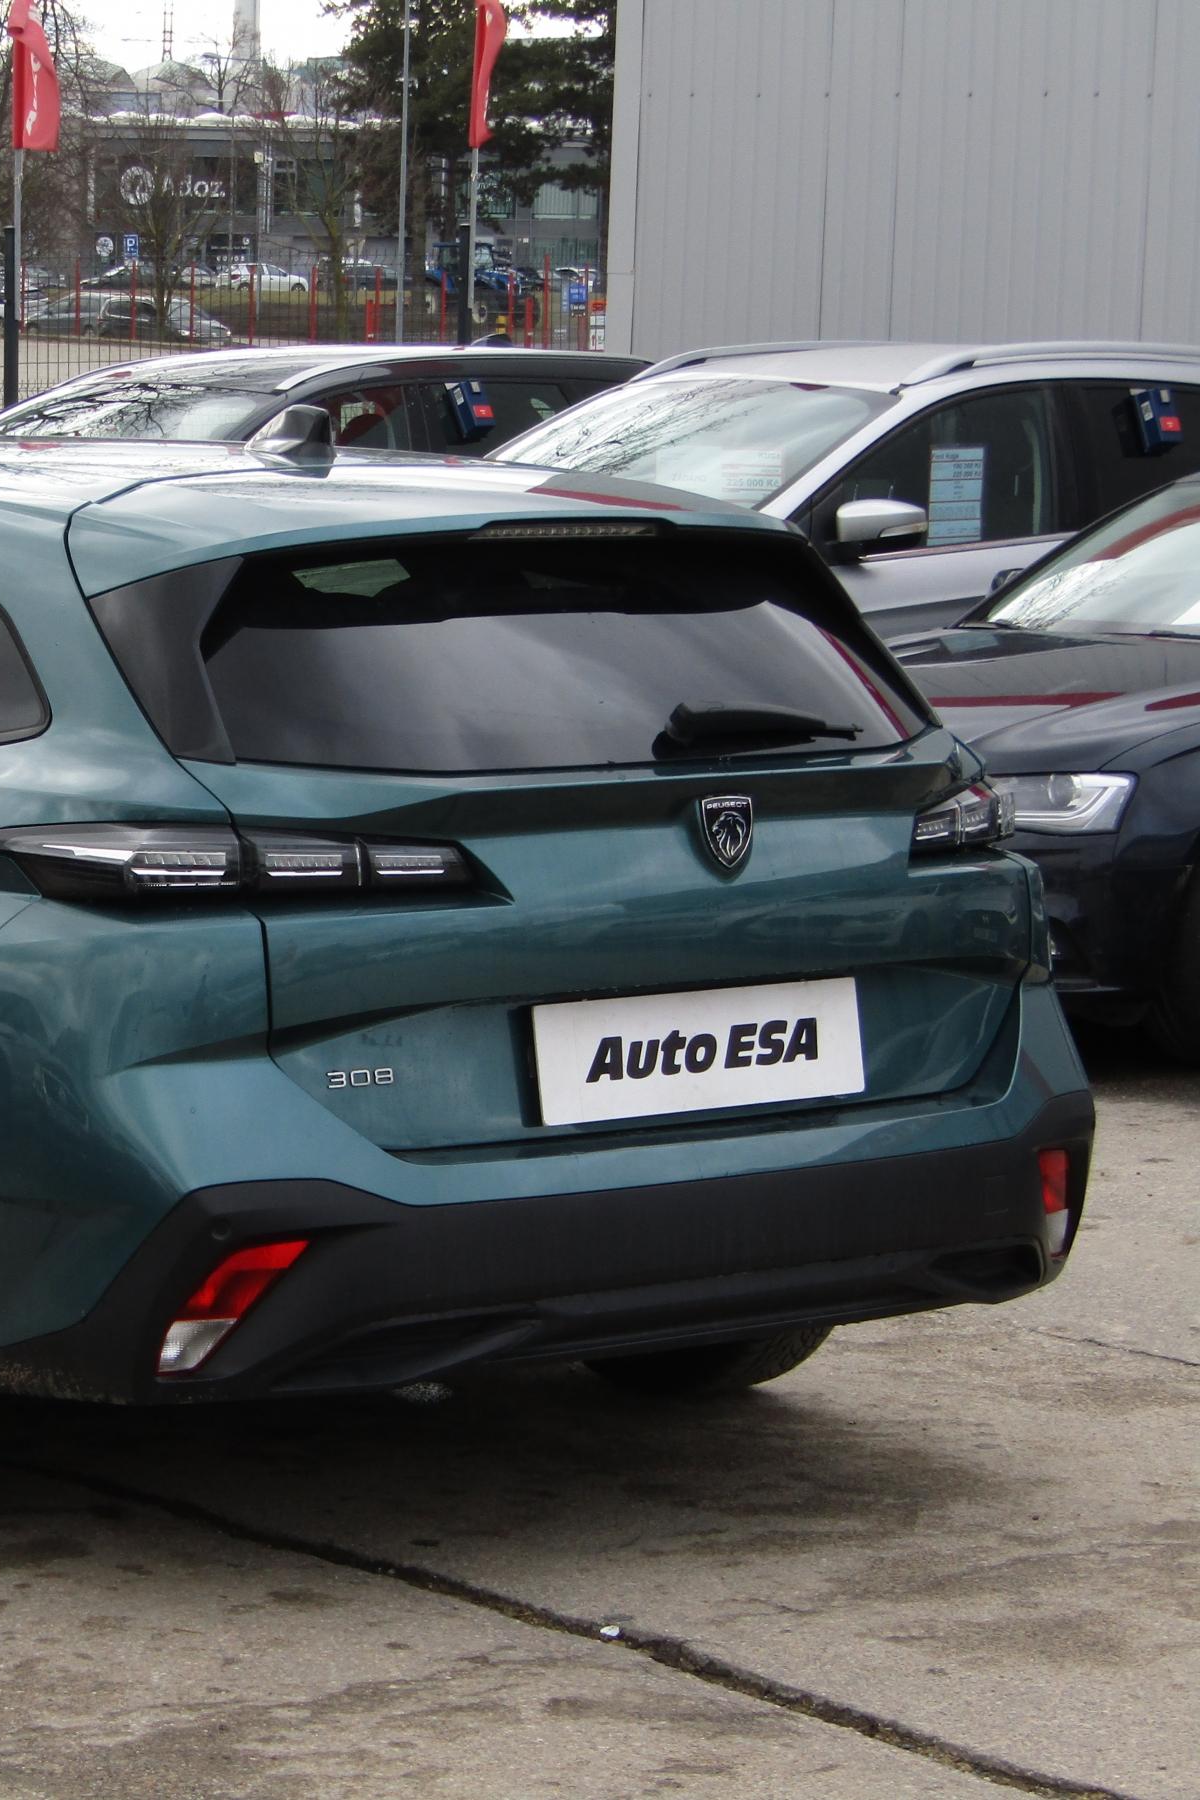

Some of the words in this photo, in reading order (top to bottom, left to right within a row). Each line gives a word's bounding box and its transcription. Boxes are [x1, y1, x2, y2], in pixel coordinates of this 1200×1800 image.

[746, 478, 765, 488] 000
[706, 801, 748, 810] PEUGEOT
[585, 1029, 718, 1084] Auto
[724, 1017, 818, 1069] ESA
[327, 1068, 394, 1089] 308
